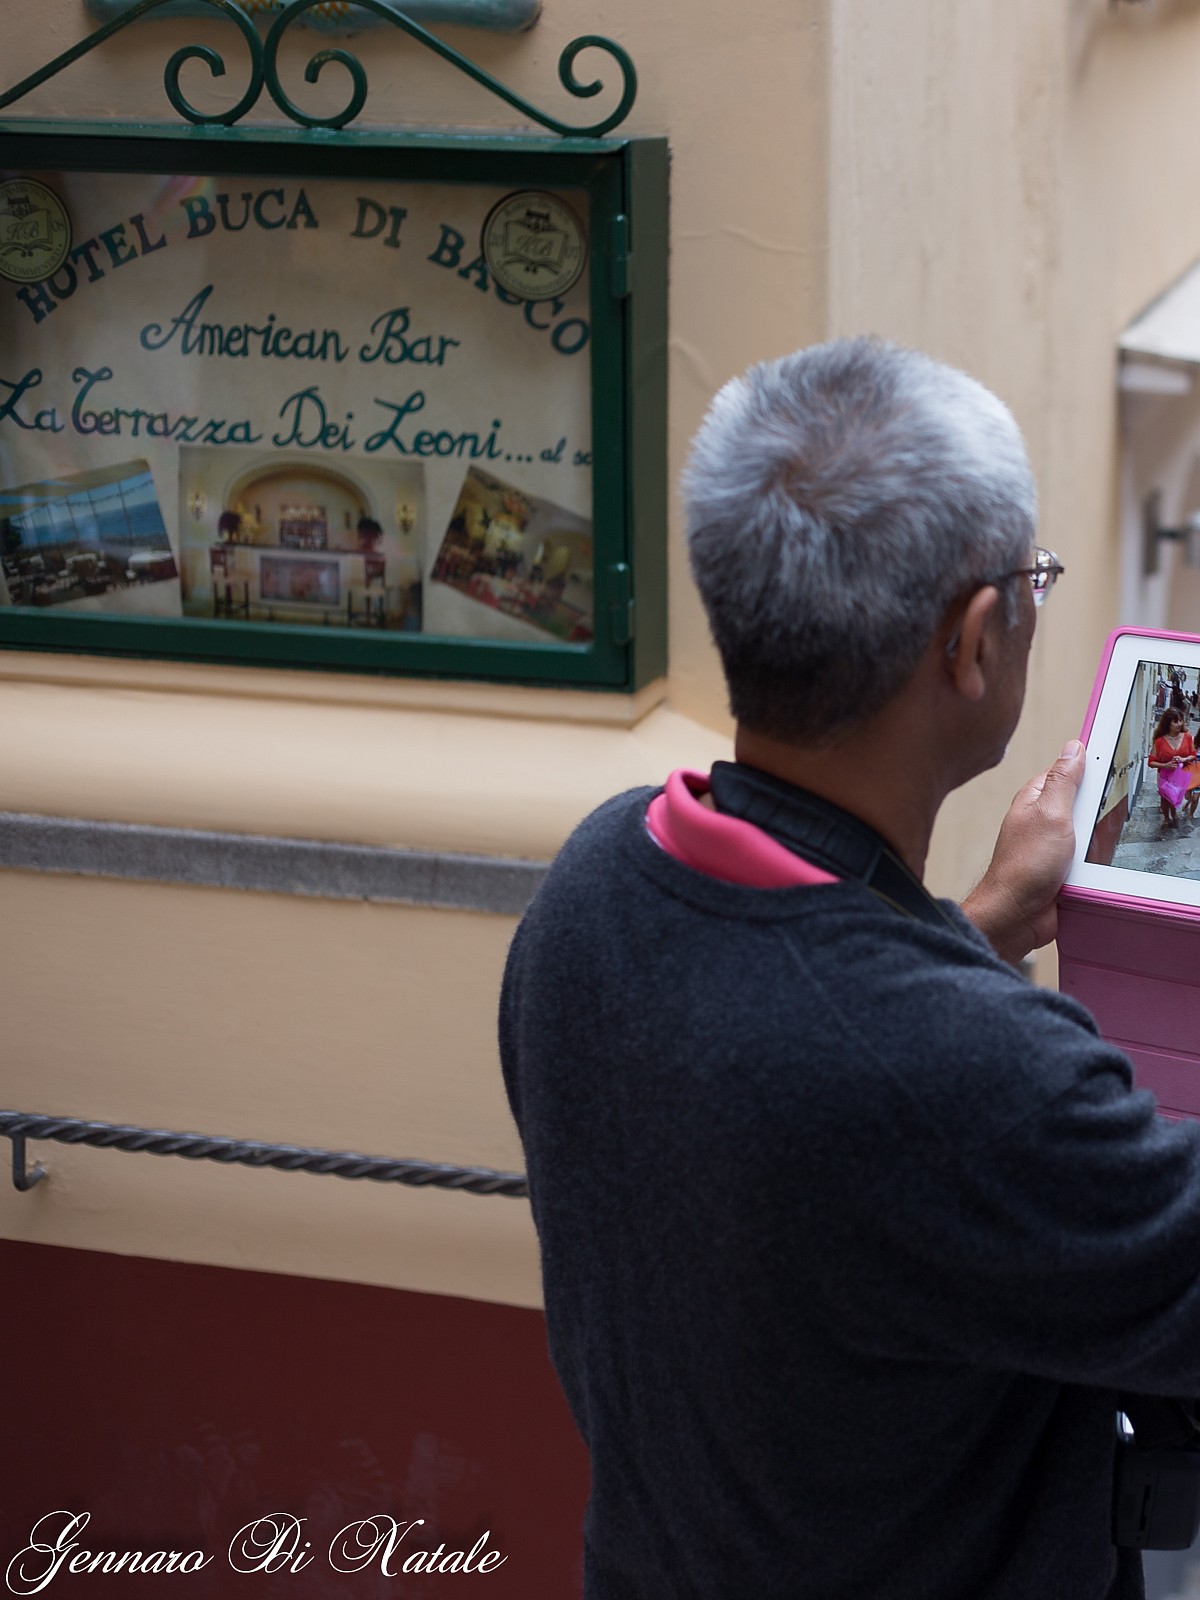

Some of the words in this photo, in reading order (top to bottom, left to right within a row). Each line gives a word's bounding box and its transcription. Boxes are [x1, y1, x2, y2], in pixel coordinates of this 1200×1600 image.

[16, 213, 167, 324] HOTEL
[180, 188, 319, 239] BUCA
[350, 197, 408, 248] DI
[140, 284, 349, 362] American
[359, 306, 461, 366] Bar
[0, 368, 65, 433] La
[71, 366, 263, 446] Terrazza
[272, 386, 355, 450] Dei
[539, 437, 567, 464] al
